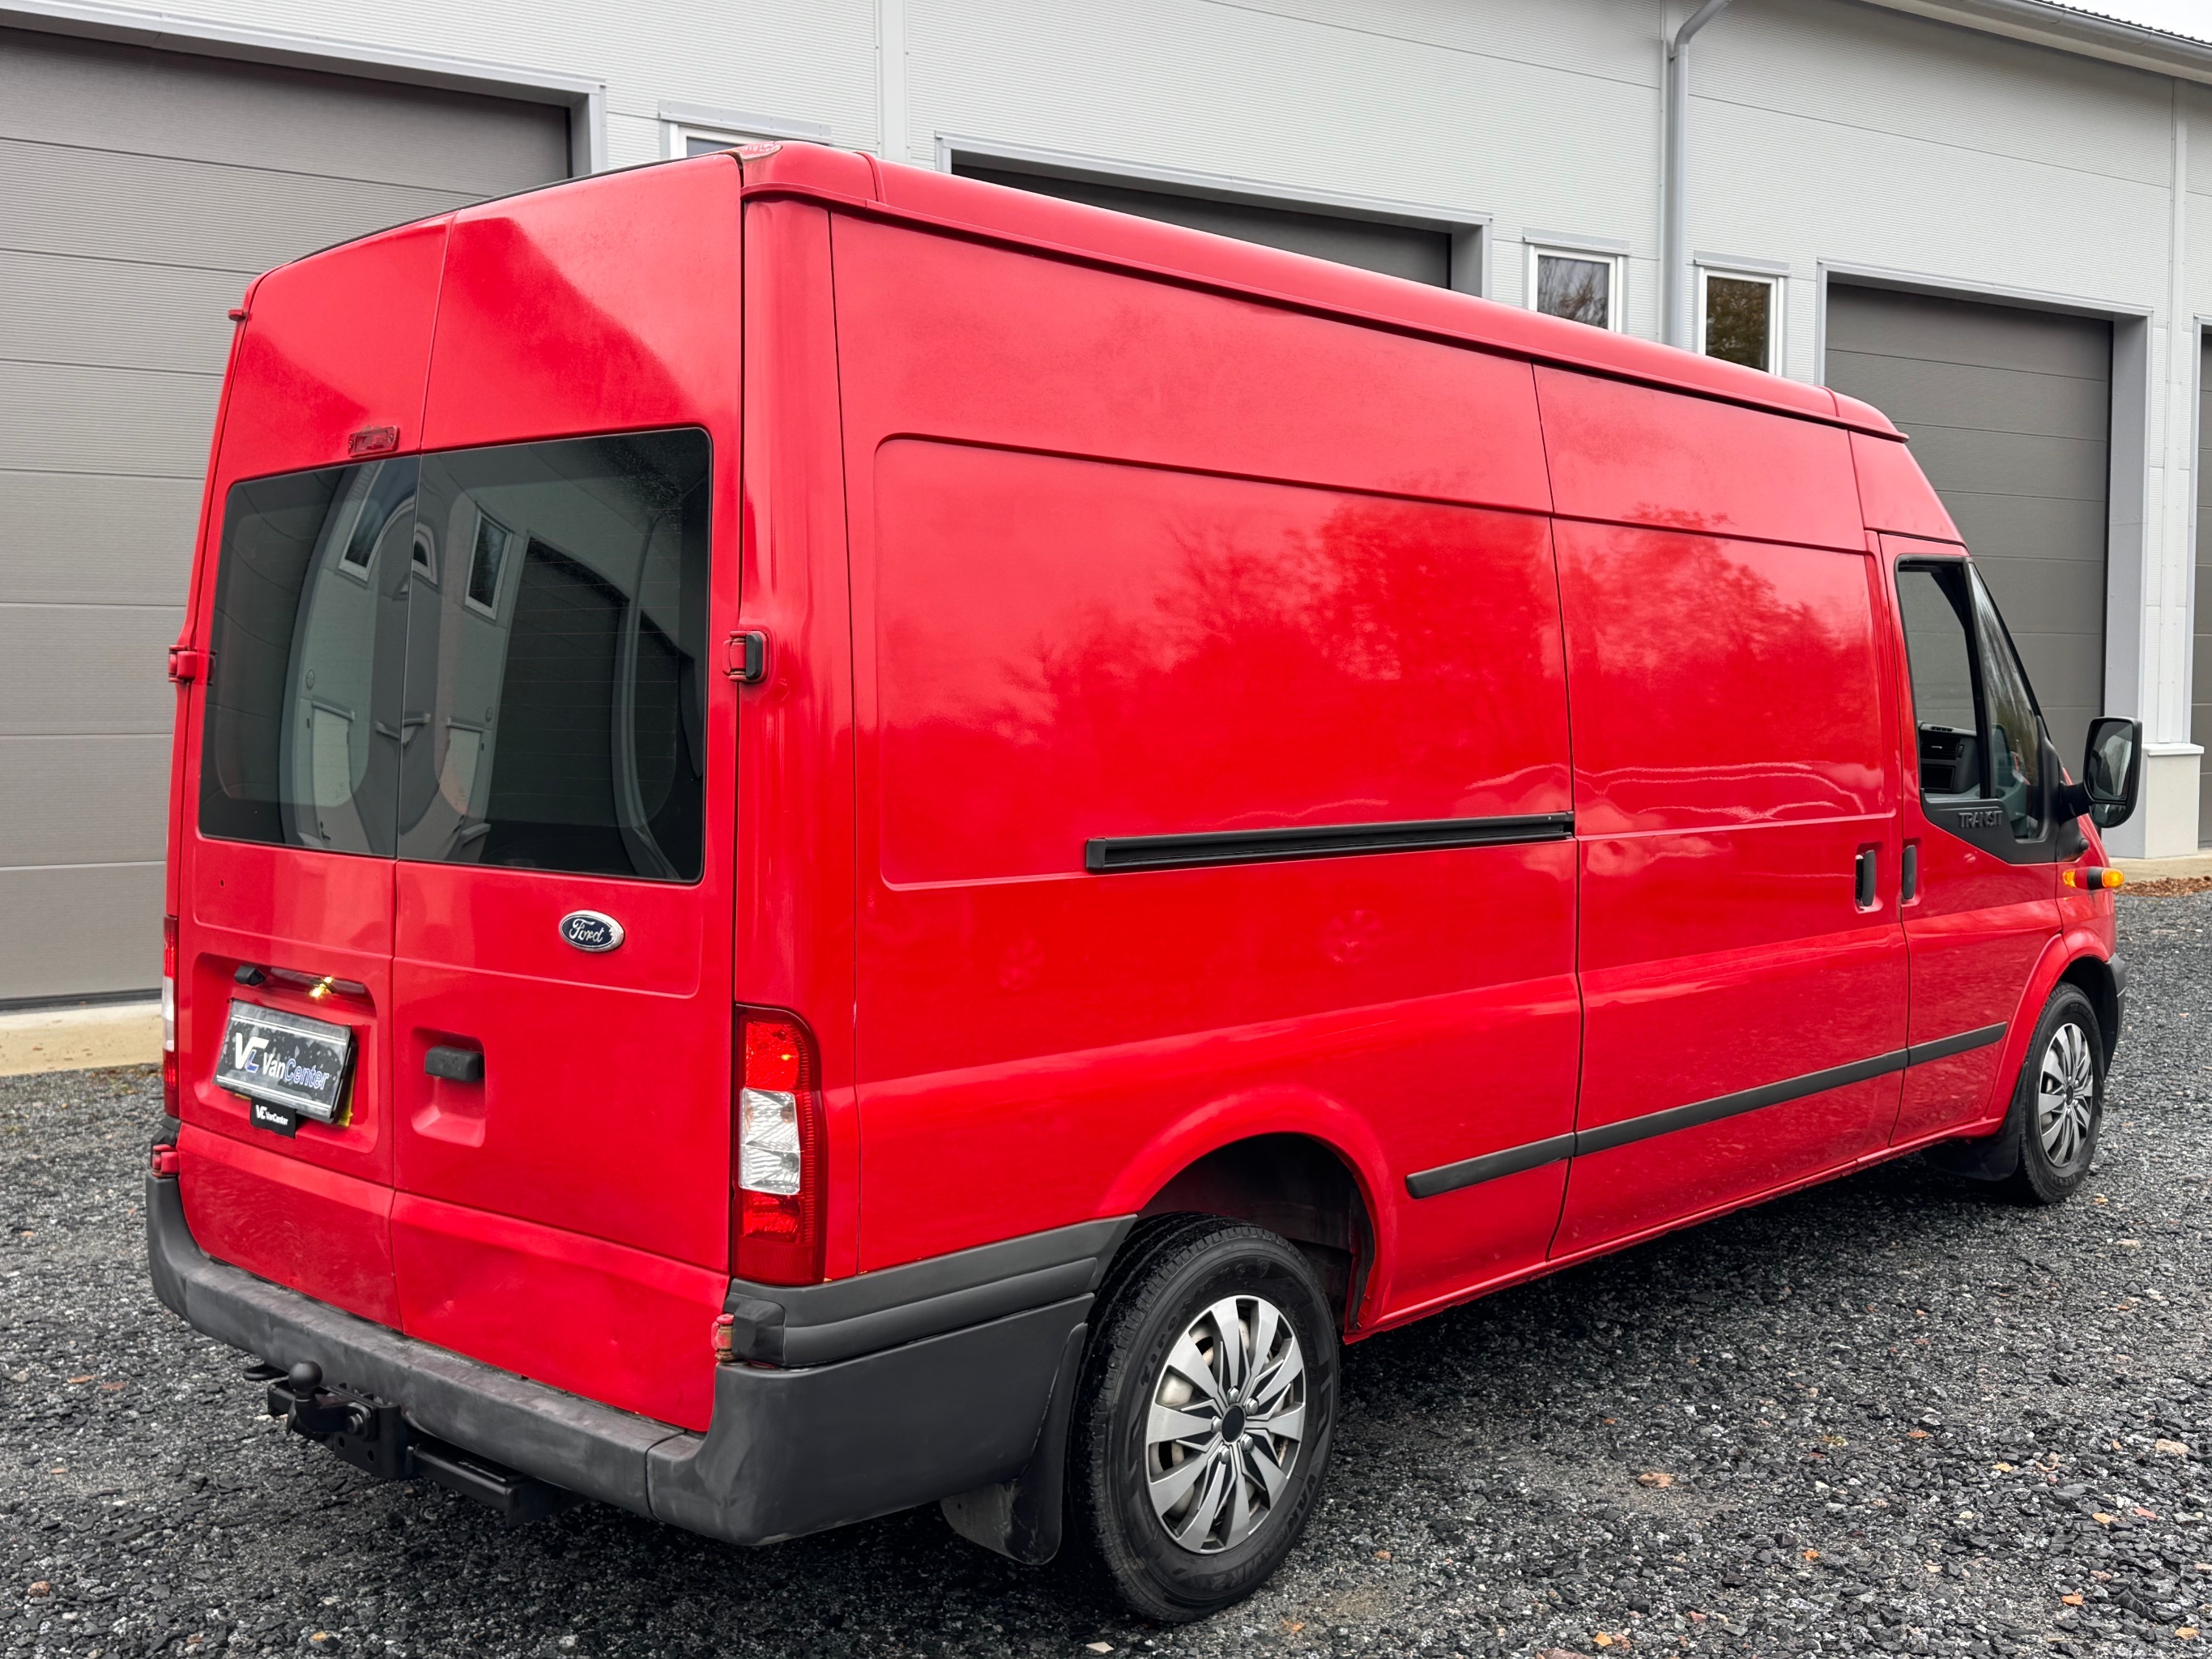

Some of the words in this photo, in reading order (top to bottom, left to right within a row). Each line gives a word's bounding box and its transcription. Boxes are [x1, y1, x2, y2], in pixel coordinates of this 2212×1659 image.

[1958, 810, 2003, 828] TRANSIT
[569, 918, 604, 943] Ford
[262, 1051, 330, 1090] VanCenter
